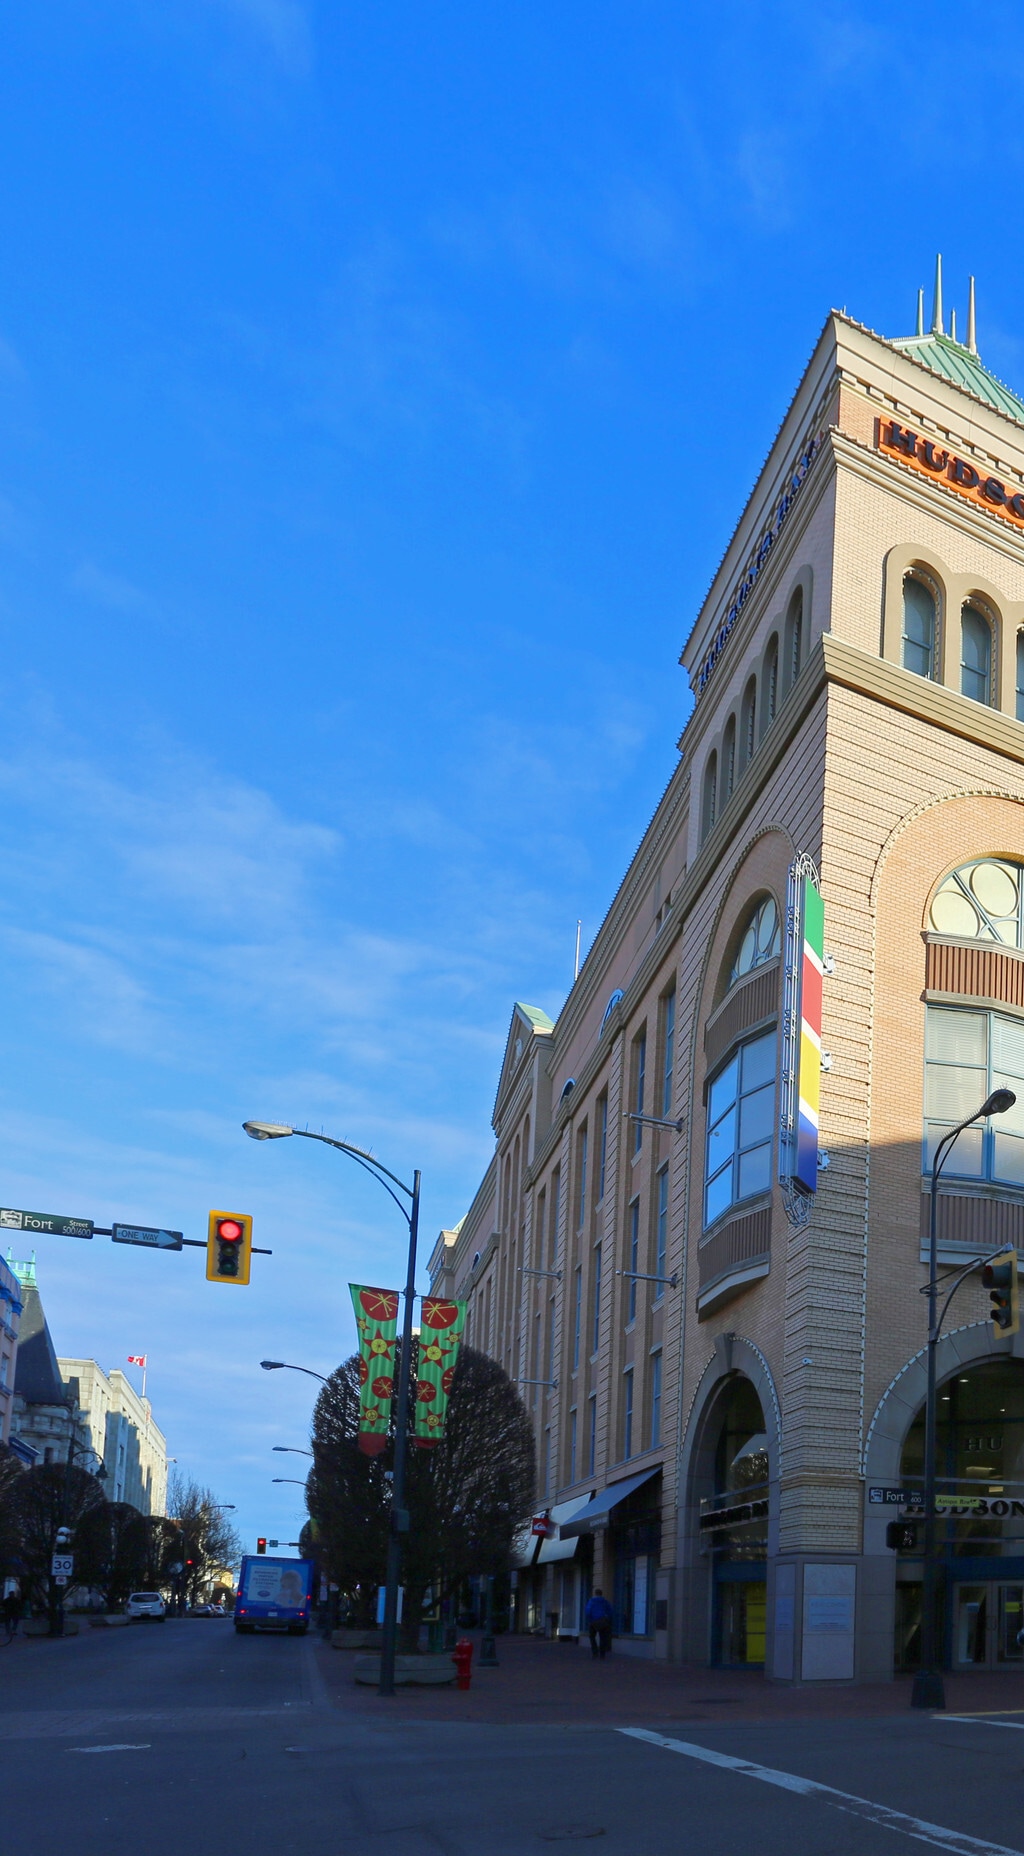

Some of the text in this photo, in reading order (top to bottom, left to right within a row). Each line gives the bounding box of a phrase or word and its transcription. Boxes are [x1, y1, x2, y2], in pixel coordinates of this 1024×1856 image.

[24, 1215, 53, 1230] Fort
[69, 1219, 89, 1229] Street
[121, 1229, 159, 1242] ONE WAY
[886, 1491, 905, 1502] Fort
[54, 1561, 71, 1570] 30
